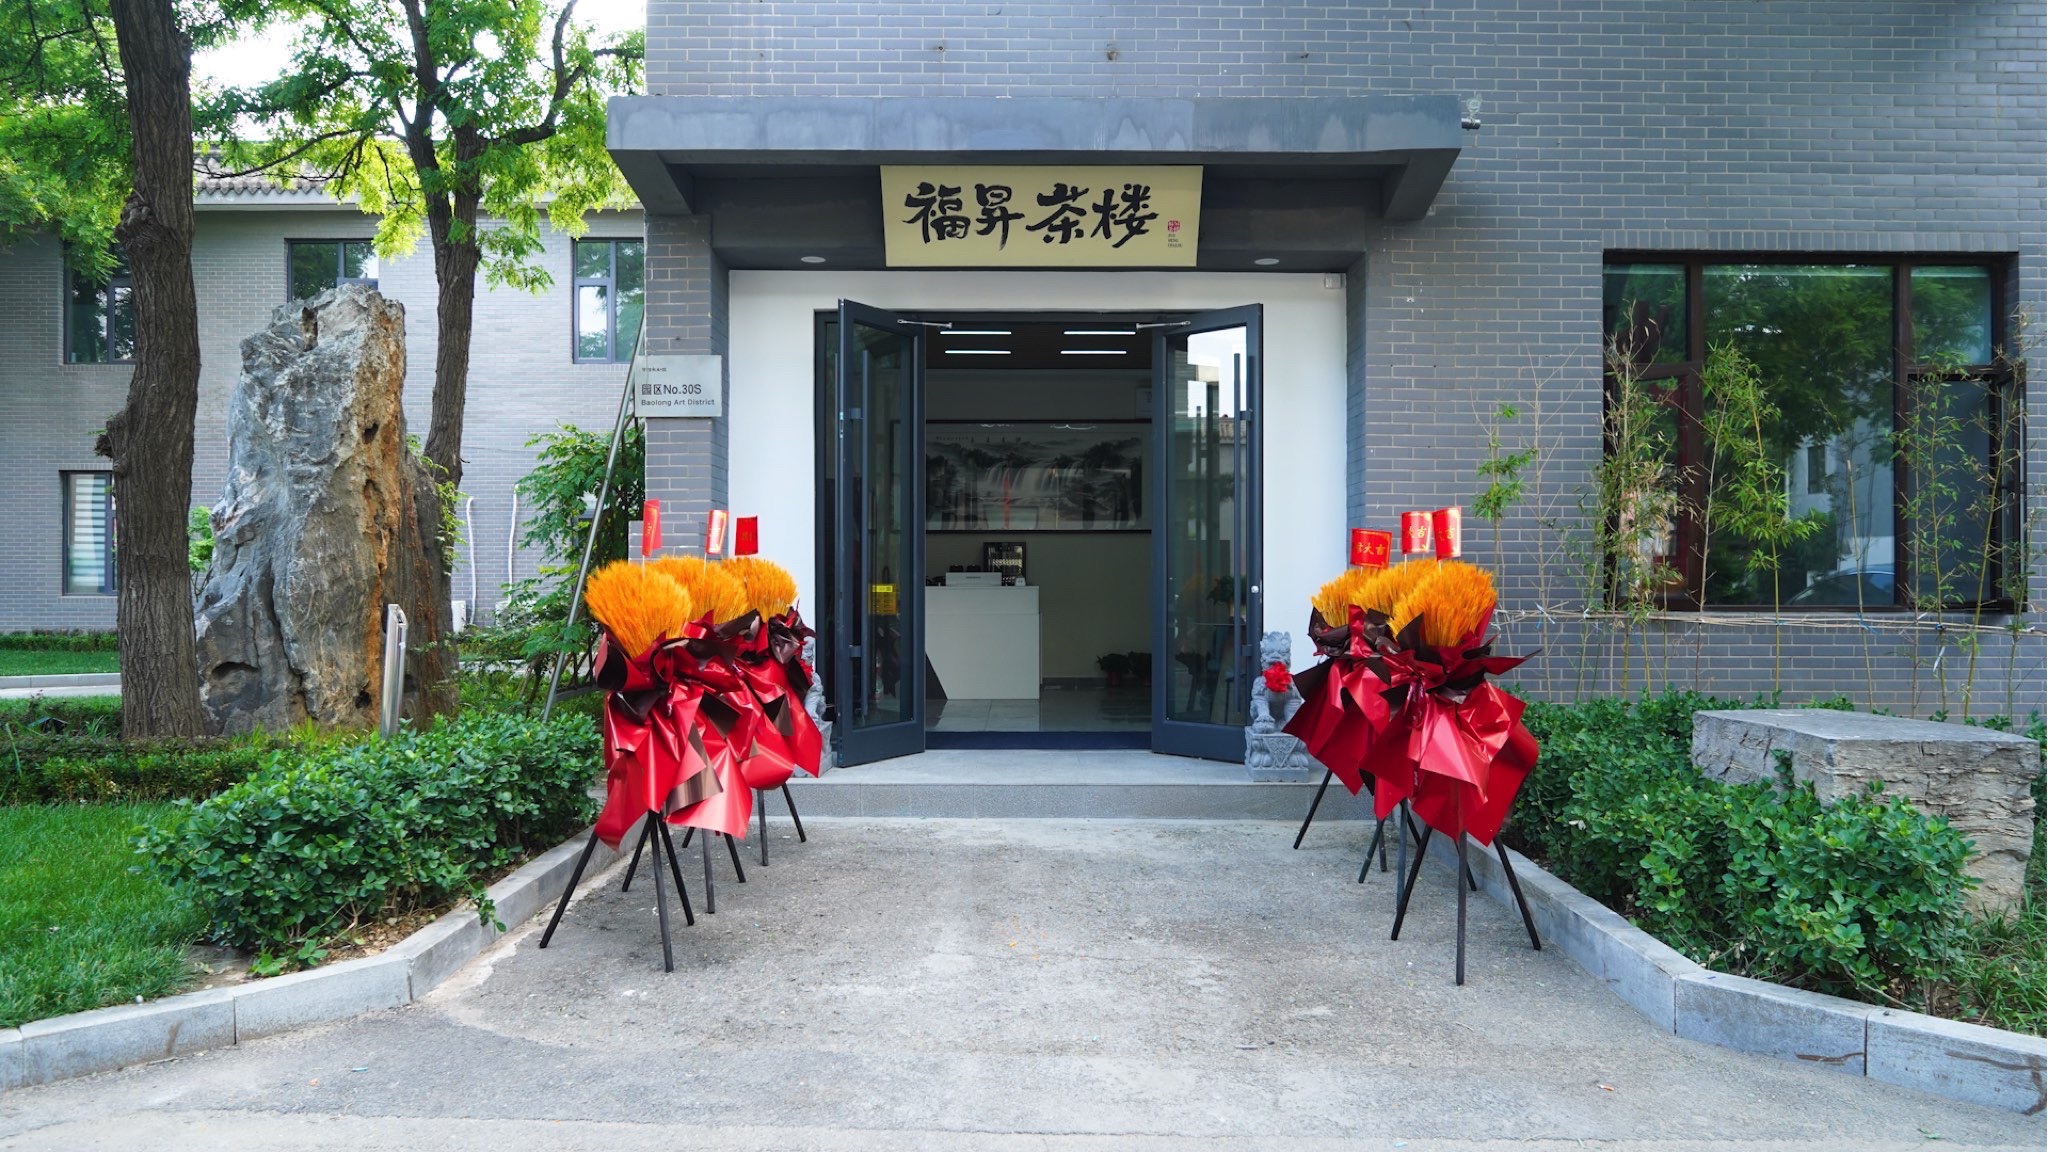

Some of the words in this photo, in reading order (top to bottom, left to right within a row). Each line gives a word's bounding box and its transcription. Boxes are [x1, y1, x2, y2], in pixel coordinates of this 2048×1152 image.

[902, 181, 1160, 251] 福昇茶楼
[641, 399, 672, 407] Baolong
[687, 398, 715, 406] District
